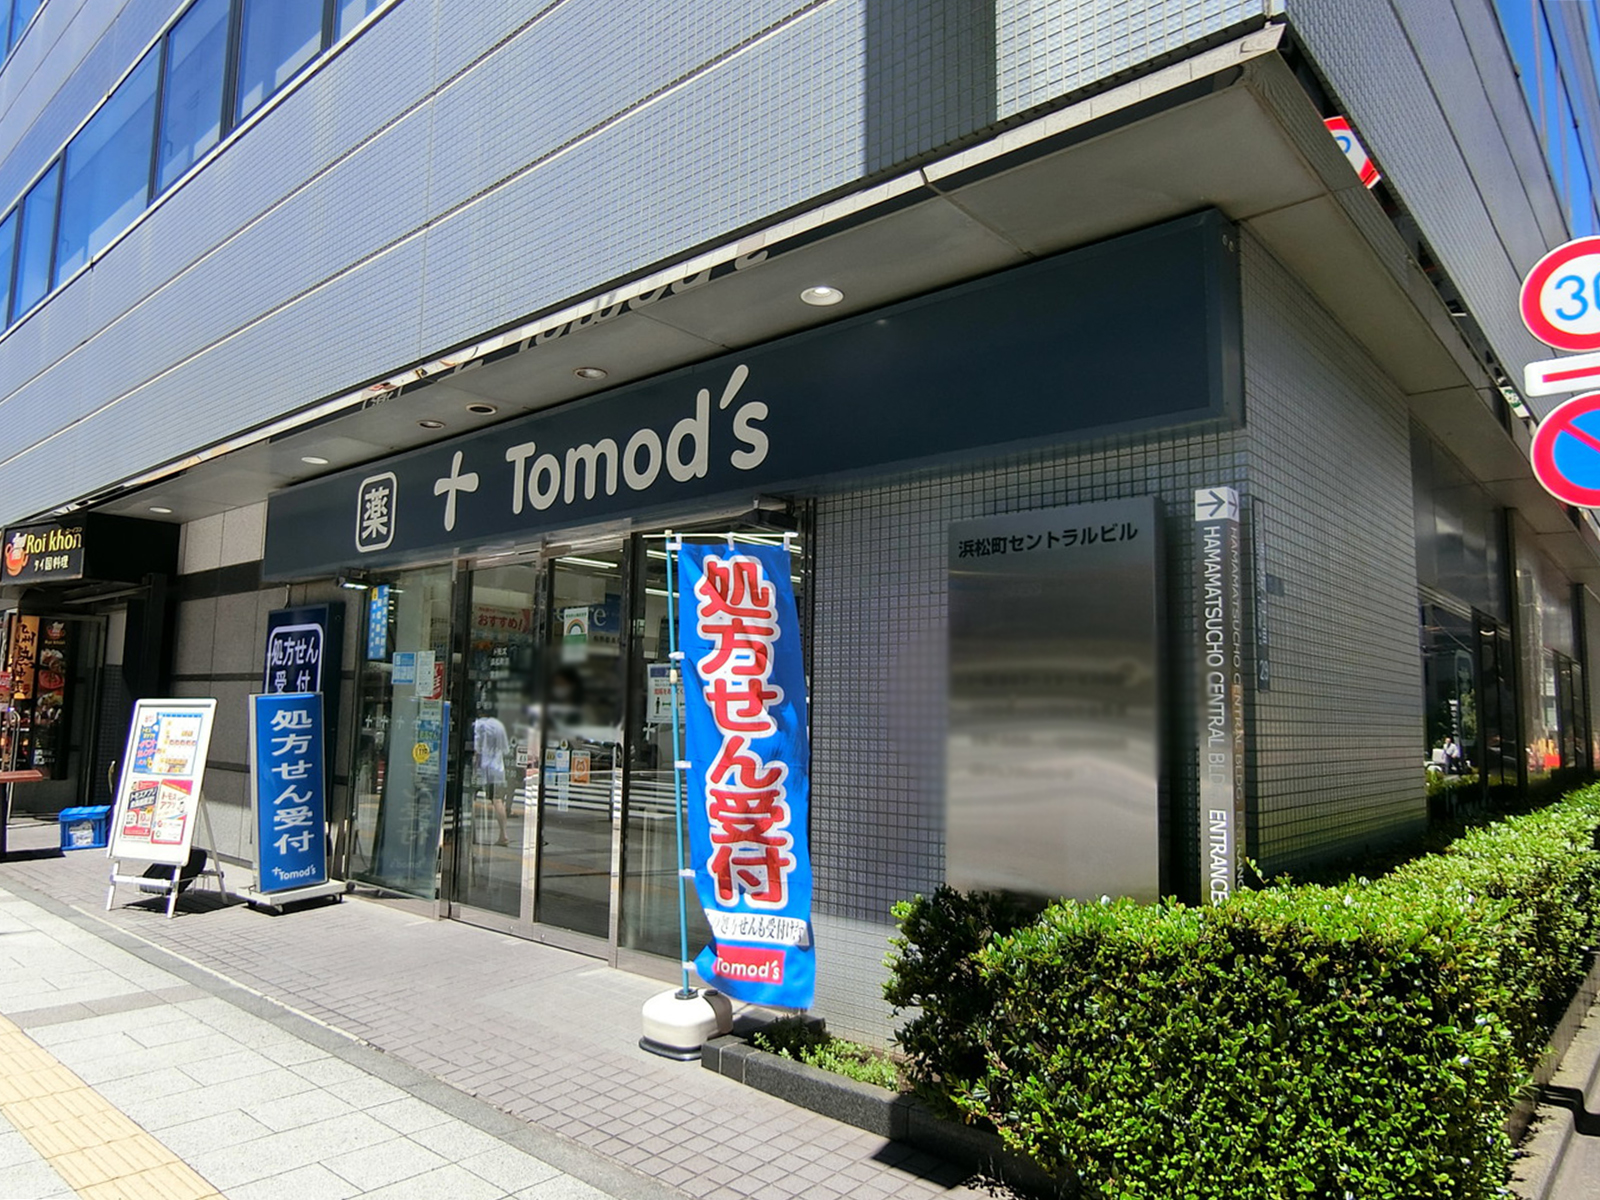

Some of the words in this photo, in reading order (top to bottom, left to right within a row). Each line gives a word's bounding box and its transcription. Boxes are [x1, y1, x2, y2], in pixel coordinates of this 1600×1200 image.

[1554, 274, 1600, 321] 3
[505, 364, 769, 515] Tomod's
[26, 533, 47, 554] Roi
[361, 486, 390, 540] 薬
[958, 522, 1138, 559] 浜松町セントラルビル
[1203, 525, 1225, 667] HAMAMATSUCHO
[1231, 526, 1243, 668] HAMAMATSUCHO
[271, 636, 319, 667] 処方せん
[274, 669, 311, 692] 受付
[696, 557, 793, 907] 処方せん受付
[1207, 671, 1226, 748] CENTRAL
[1233, 672, 1244, 749] CENTRAL
[270, 709, 315, 856] 処方せん受付
[1209, 809, 1229, 905] ENTRANCE
[716, 957, 780, 981] Tomod's
